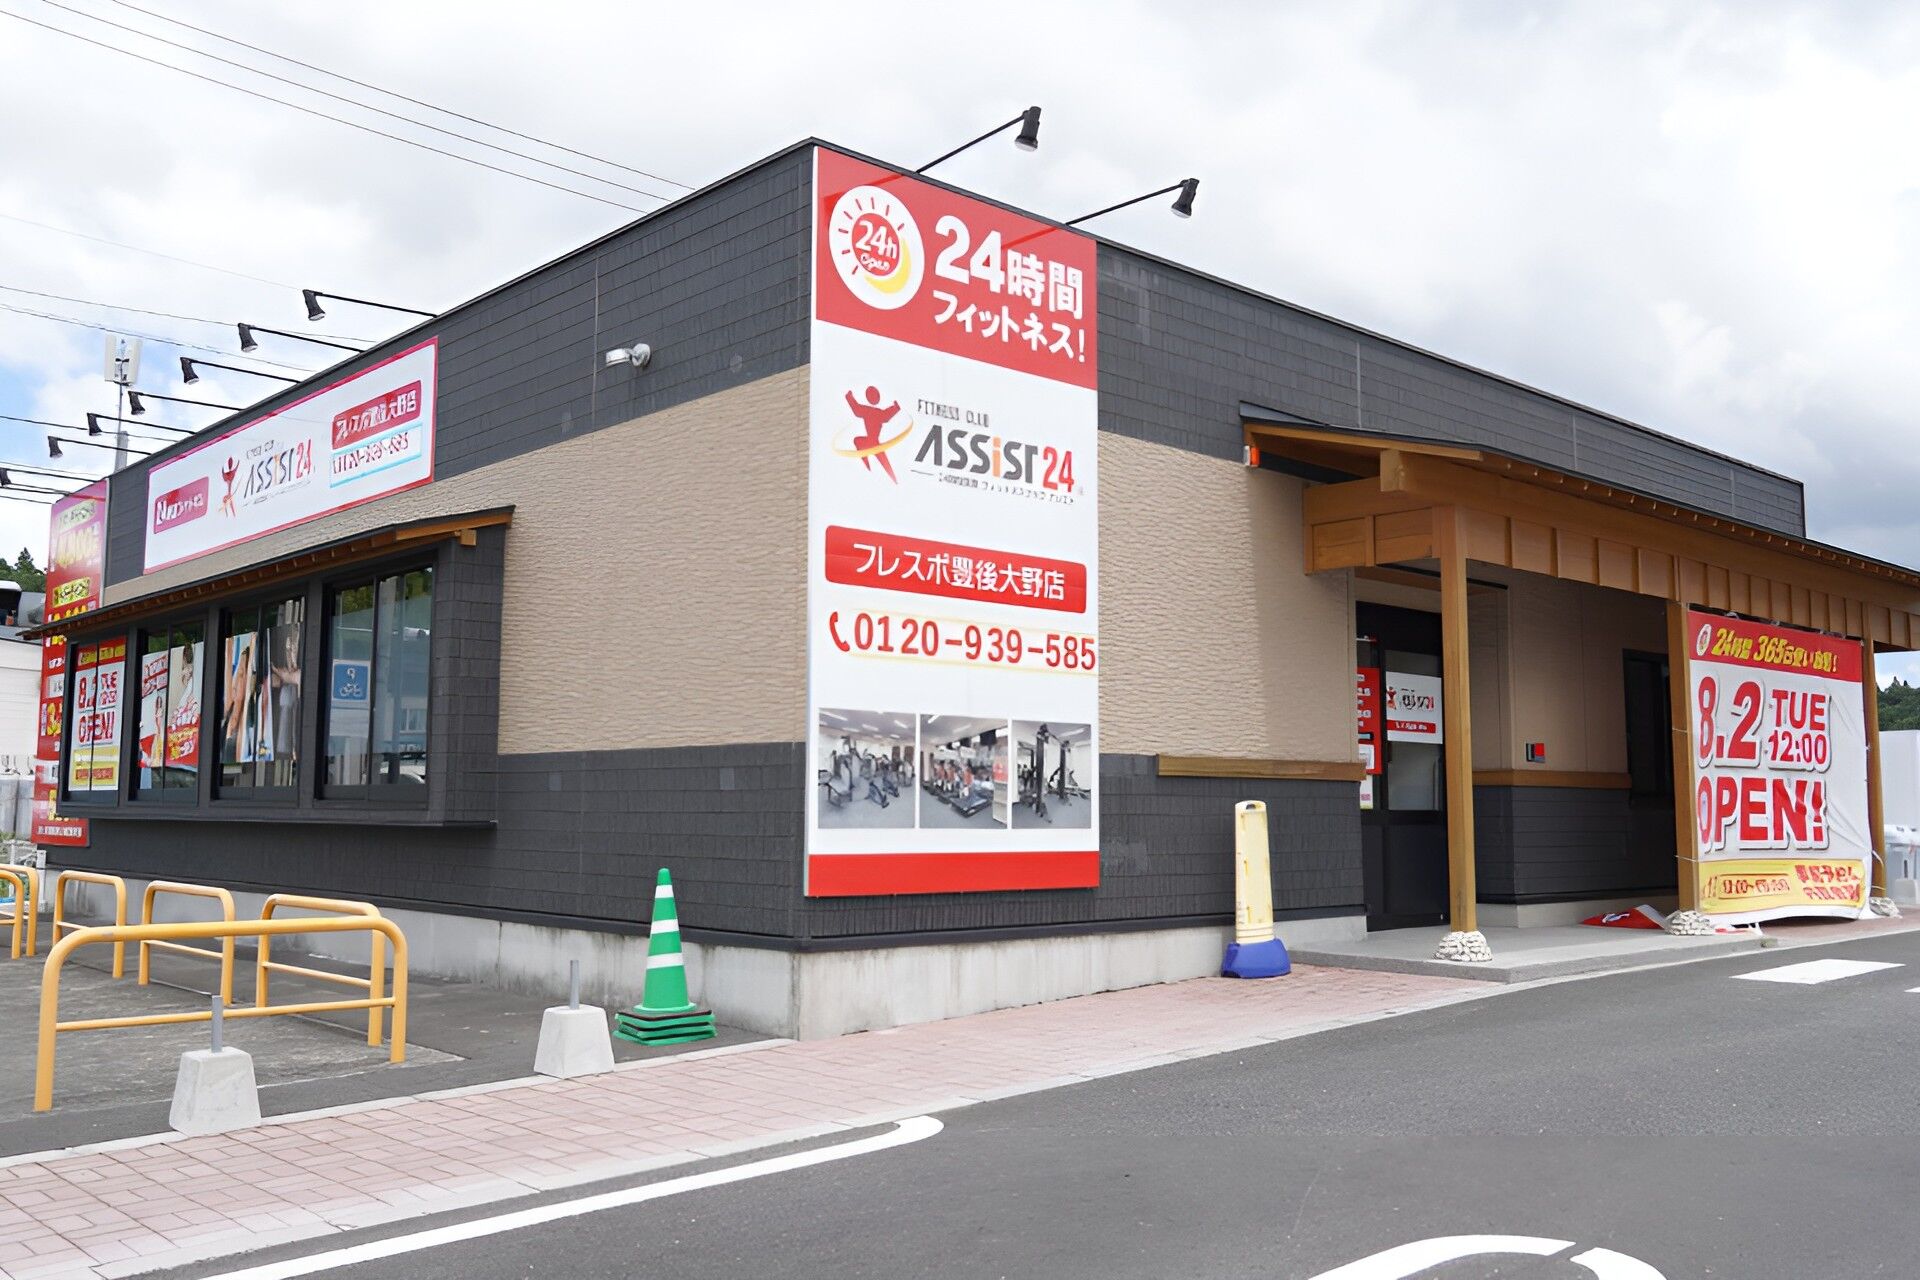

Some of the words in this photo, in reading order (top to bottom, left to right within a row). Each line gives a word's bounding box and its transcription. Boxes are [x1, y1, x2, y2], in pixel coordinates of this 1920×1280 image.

[855, 219, 898, 259] 24h
[934, 214, 1084, 320] 24時間
[852, 542, 1066, 601] フレスポ豊後大野店
[852, 611, 1097, 672] 0120-939-585
[1698, 676, 1762, 760] 8.2
[1772, 689, 1826, 731] TUE
[1768, 730, 1827, 764] 12:00
[1697, 775, 1825, 845] OPEN!
